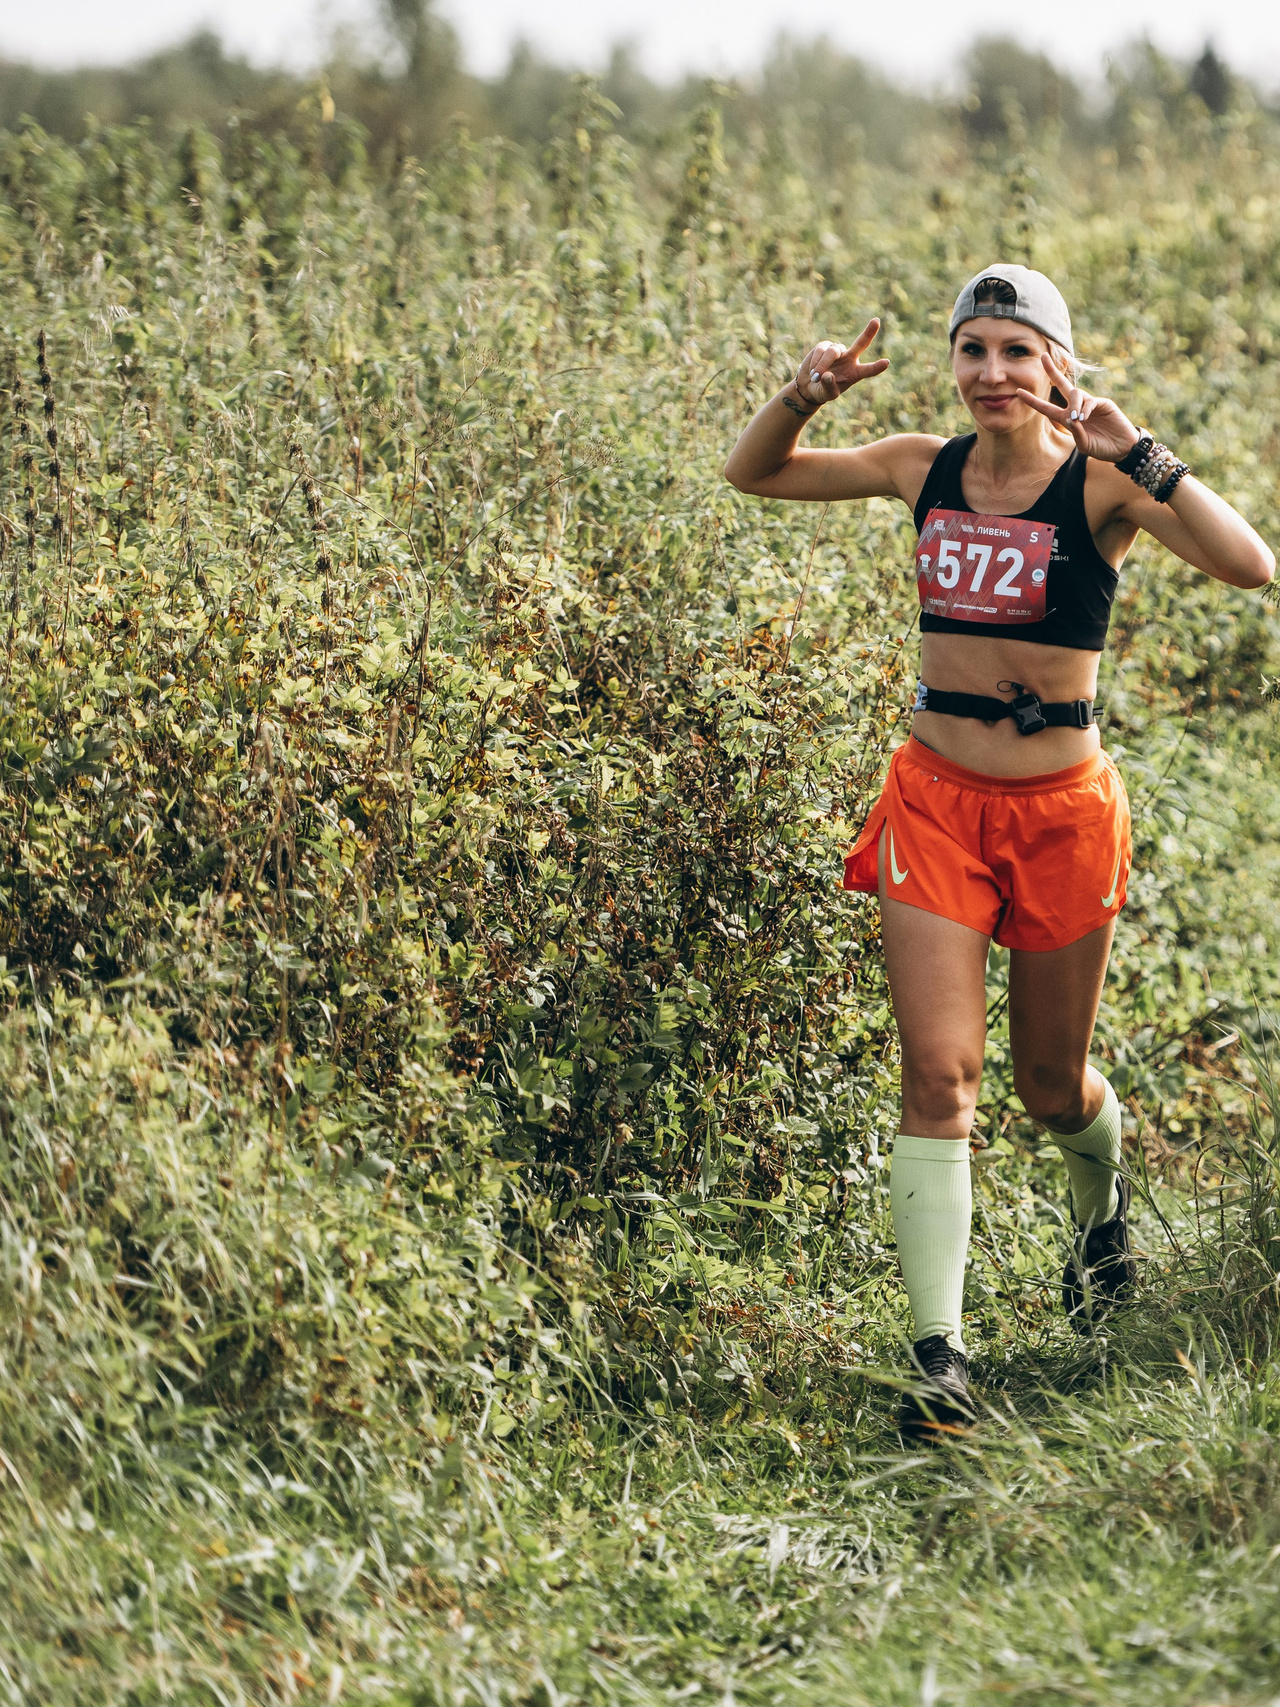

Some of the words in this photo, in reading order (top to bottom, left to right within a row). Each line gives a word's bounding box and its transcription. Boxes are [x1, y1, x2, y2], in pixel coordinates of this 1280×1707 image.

[976, 526, 1011, 538] ЛИВЕНЬ
[1029, 532, 1039, 543] S
[936, 539, 1025, 598] 572
